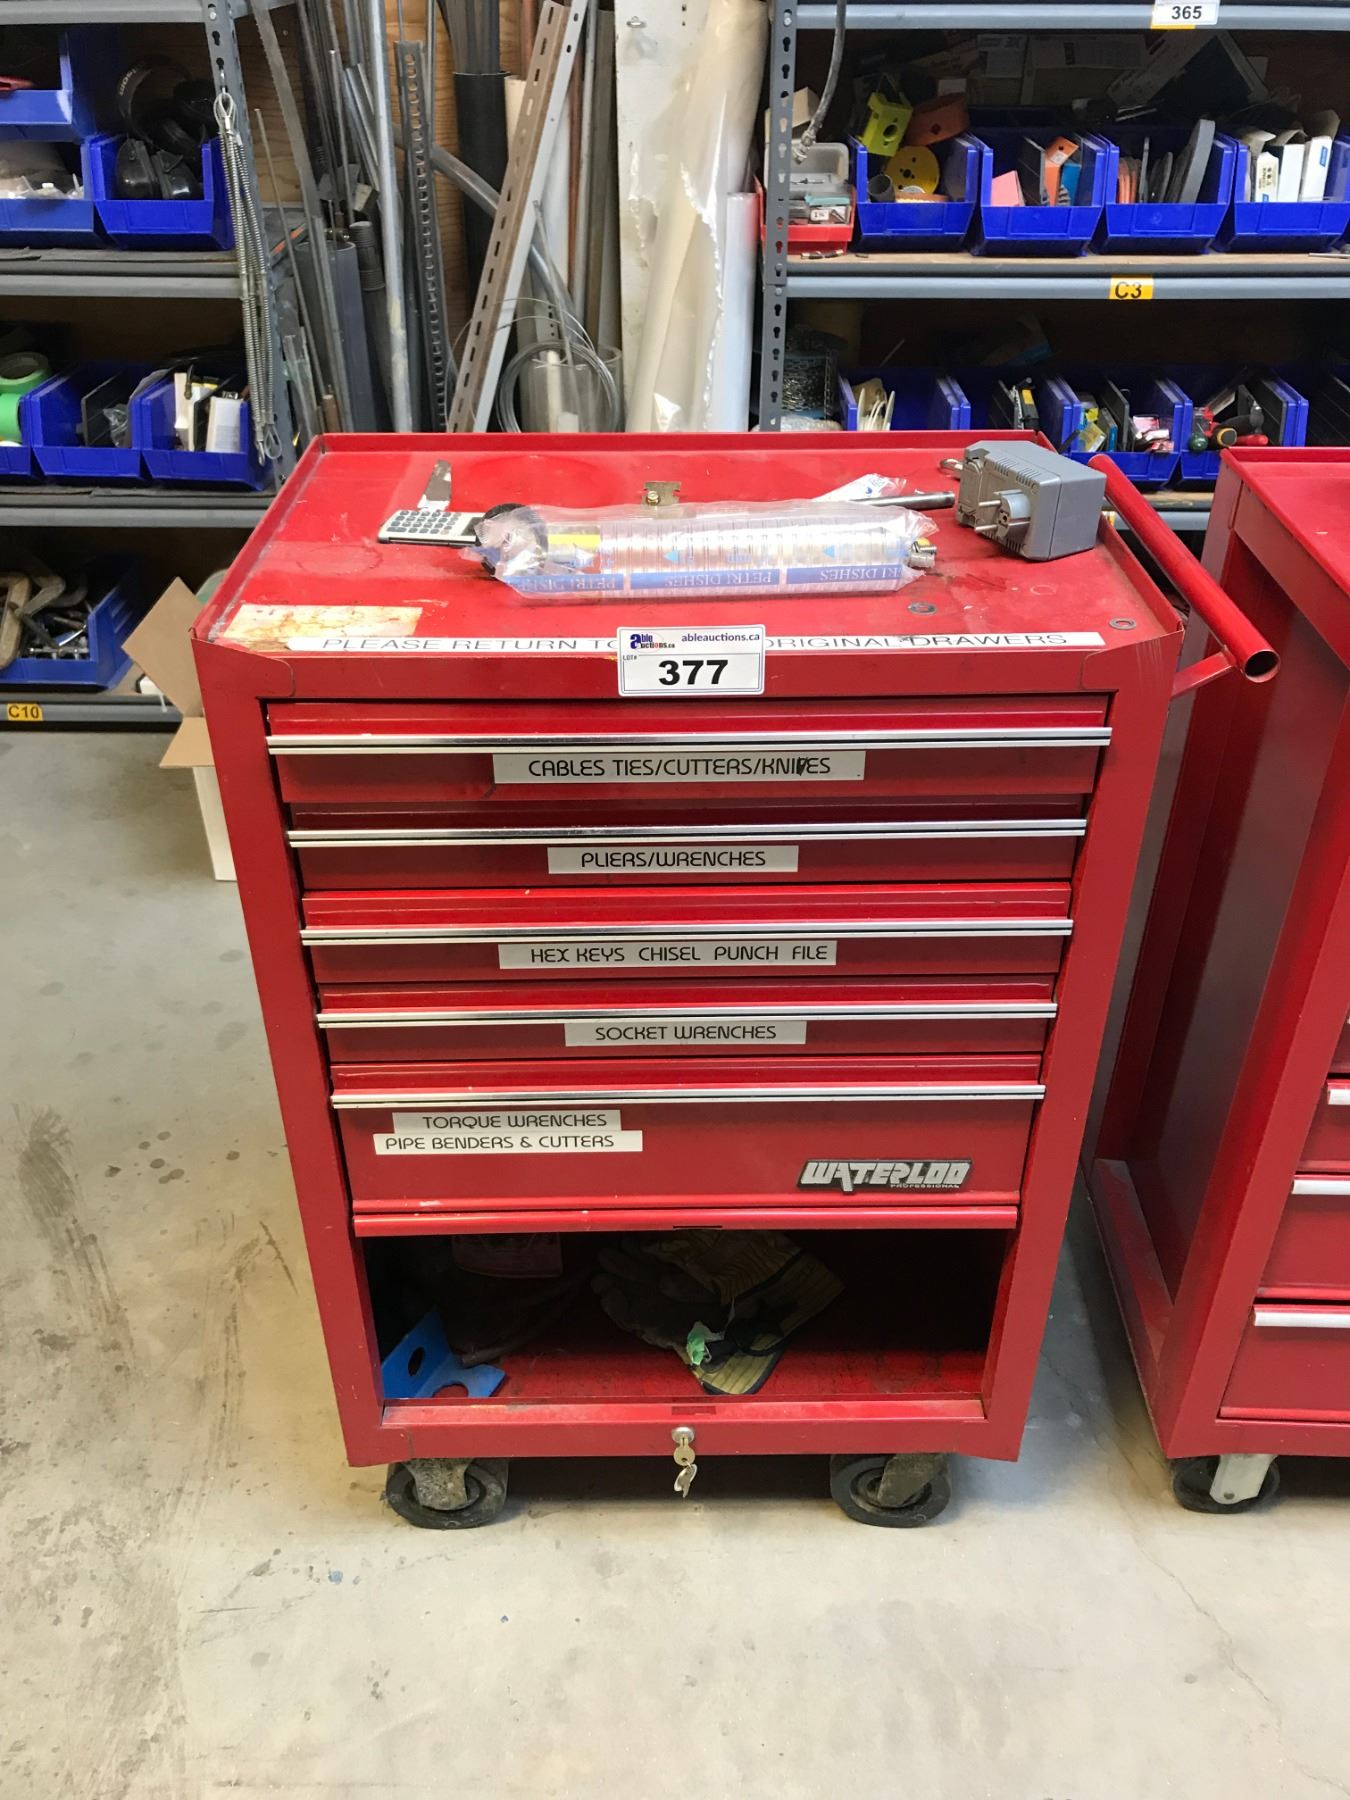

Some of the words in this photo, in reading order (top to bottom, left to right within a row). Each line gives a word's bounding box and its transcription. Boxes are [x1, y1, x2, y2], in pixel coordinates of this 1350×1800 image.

[1171, 5, 1202, 20] 365
[1115, 281, 1142, 299] C3
[726, 571, 772, 585] PETRI
[322, 639, 438, 649] PLEASE
[451, 639, 577, 649] RETURN
[681, 633, 760, 642] ableauctions.ca
[906, 634, 1067, 647] DRAWERS
[658, 659, 728, 686] 377
[8, 705, 40, 719] C10
[528, 760, 605, 777] CABLES
[581, 851, 766, 868] PLIERS/WRENCHES
[530, 948, 569, 963] HEX
[576, 947, 625, 962] KEYS
[639, 946, 701, 961] CHISEL
[714, 945, 779, 961] PUNCH
[792, 945, 827, 960] FILE
[595, 1026, 667, 1041] SOCKET
[674, 1025, 777, 1040] WRENCHES
[422, 1116, 501, 1130] TORQUE
[508, 1113, 608, 1128] WRENCHES
[385, 1137, 425, 1150] PIPE
[432, 1136, 514, 1150] BENDERS
[519, 1136, 533, 1148] &
[538, 1134, 615, 1148] CUTTERS
[799, 1161, 971, 1192] WATERLOO
